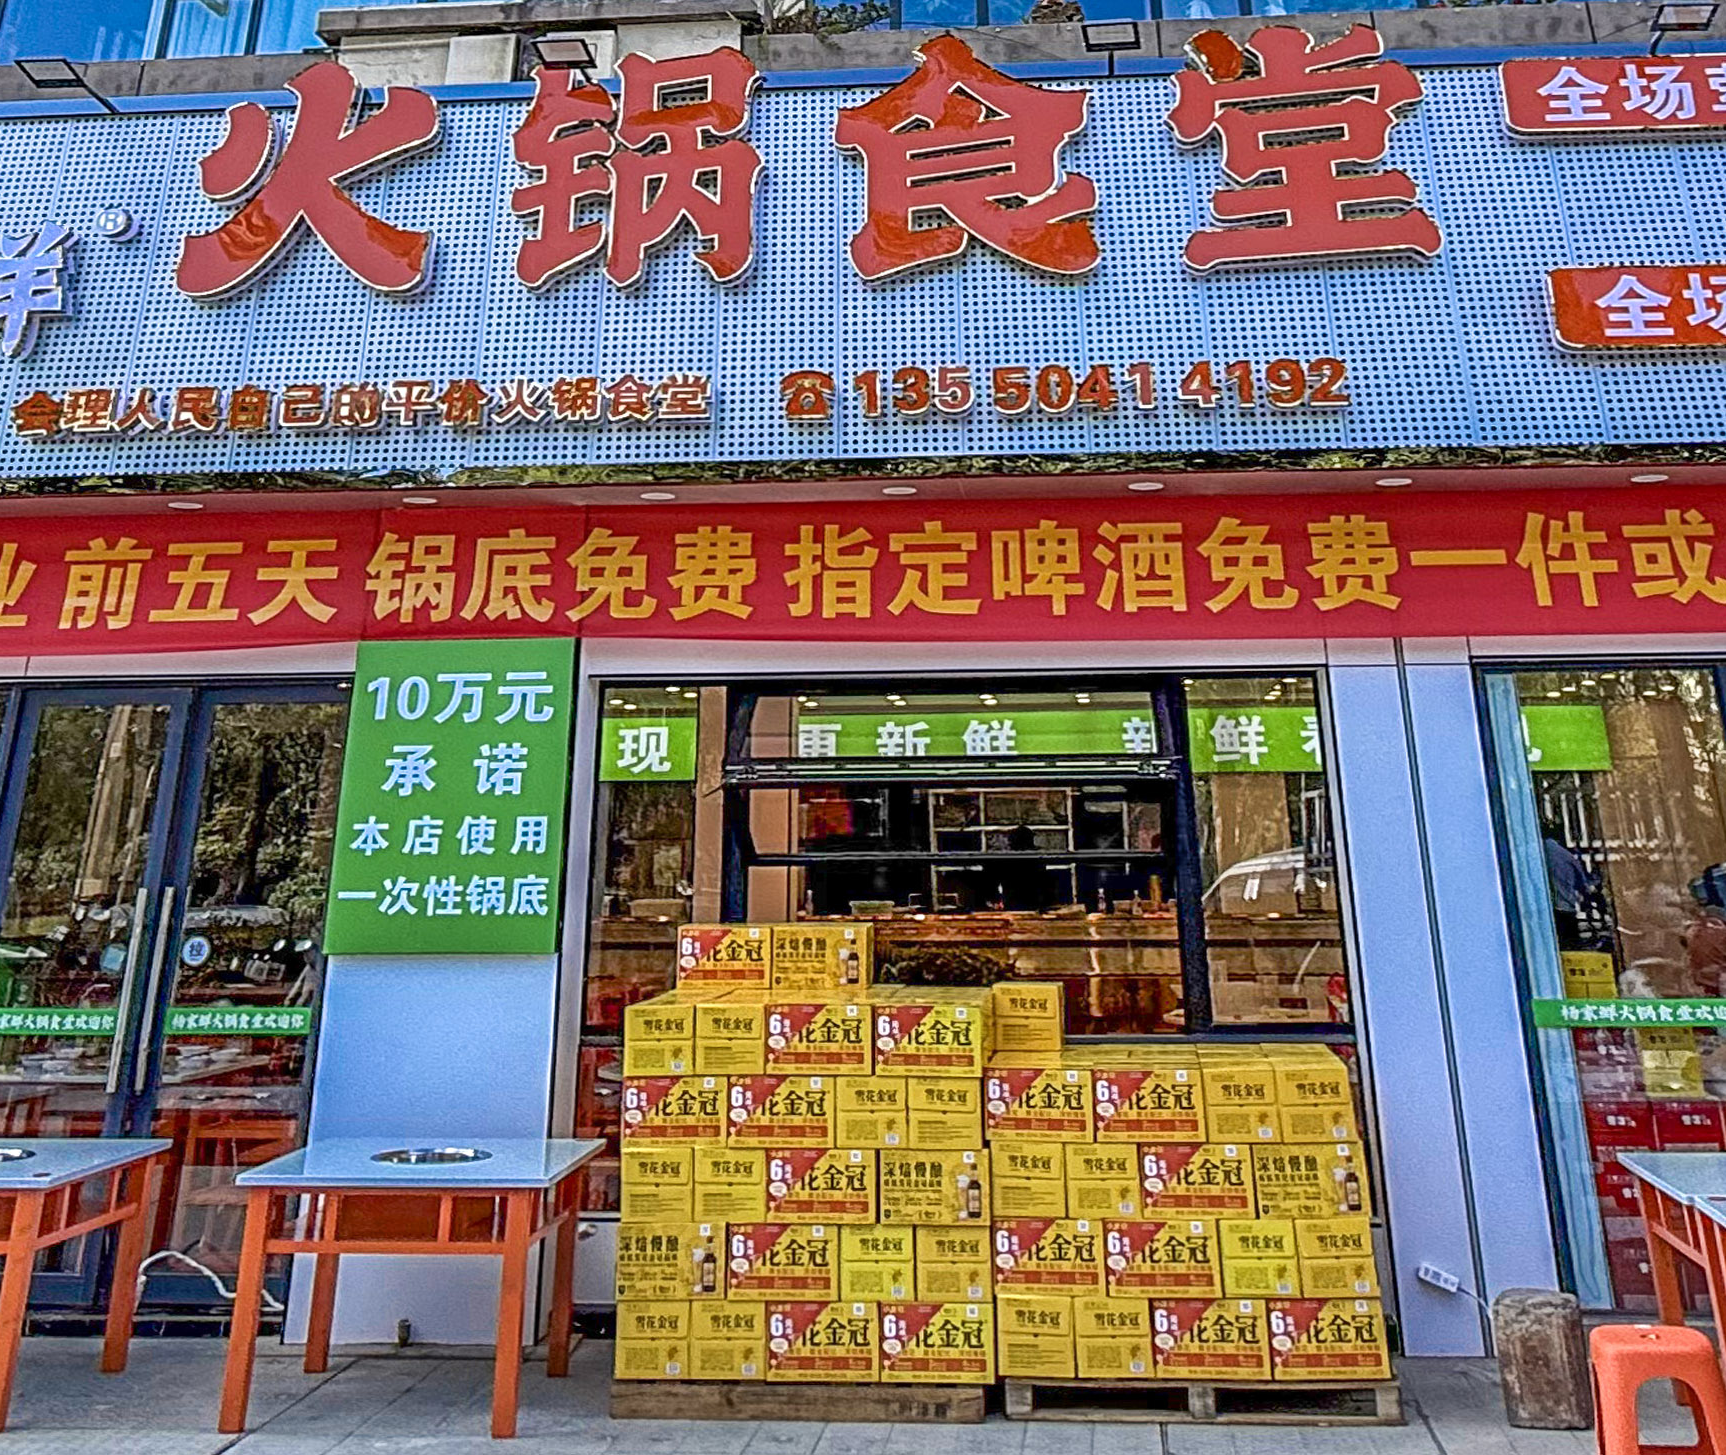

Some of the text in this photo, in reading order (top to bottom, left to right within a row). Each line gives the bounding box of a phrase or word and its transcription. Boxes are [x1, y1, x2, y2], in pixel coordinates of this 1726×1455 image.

[175, 22, 1443, 301] 火锅食堂
[12, 374, 715, 436] 会理人民自己的平价火锅食堂
[852, 356, 1352, 418] 135 5041 4192
[57, 536, 339, 631] 前五天
[364, 526, 757, 623] 锅底免费
[366, 671, 555, 725] 10万元
[381, 743, 528, 797] 承诺
[350, 815, 550, 857] 本店使用
[337, 874, 550, 917] 一次性锅底
